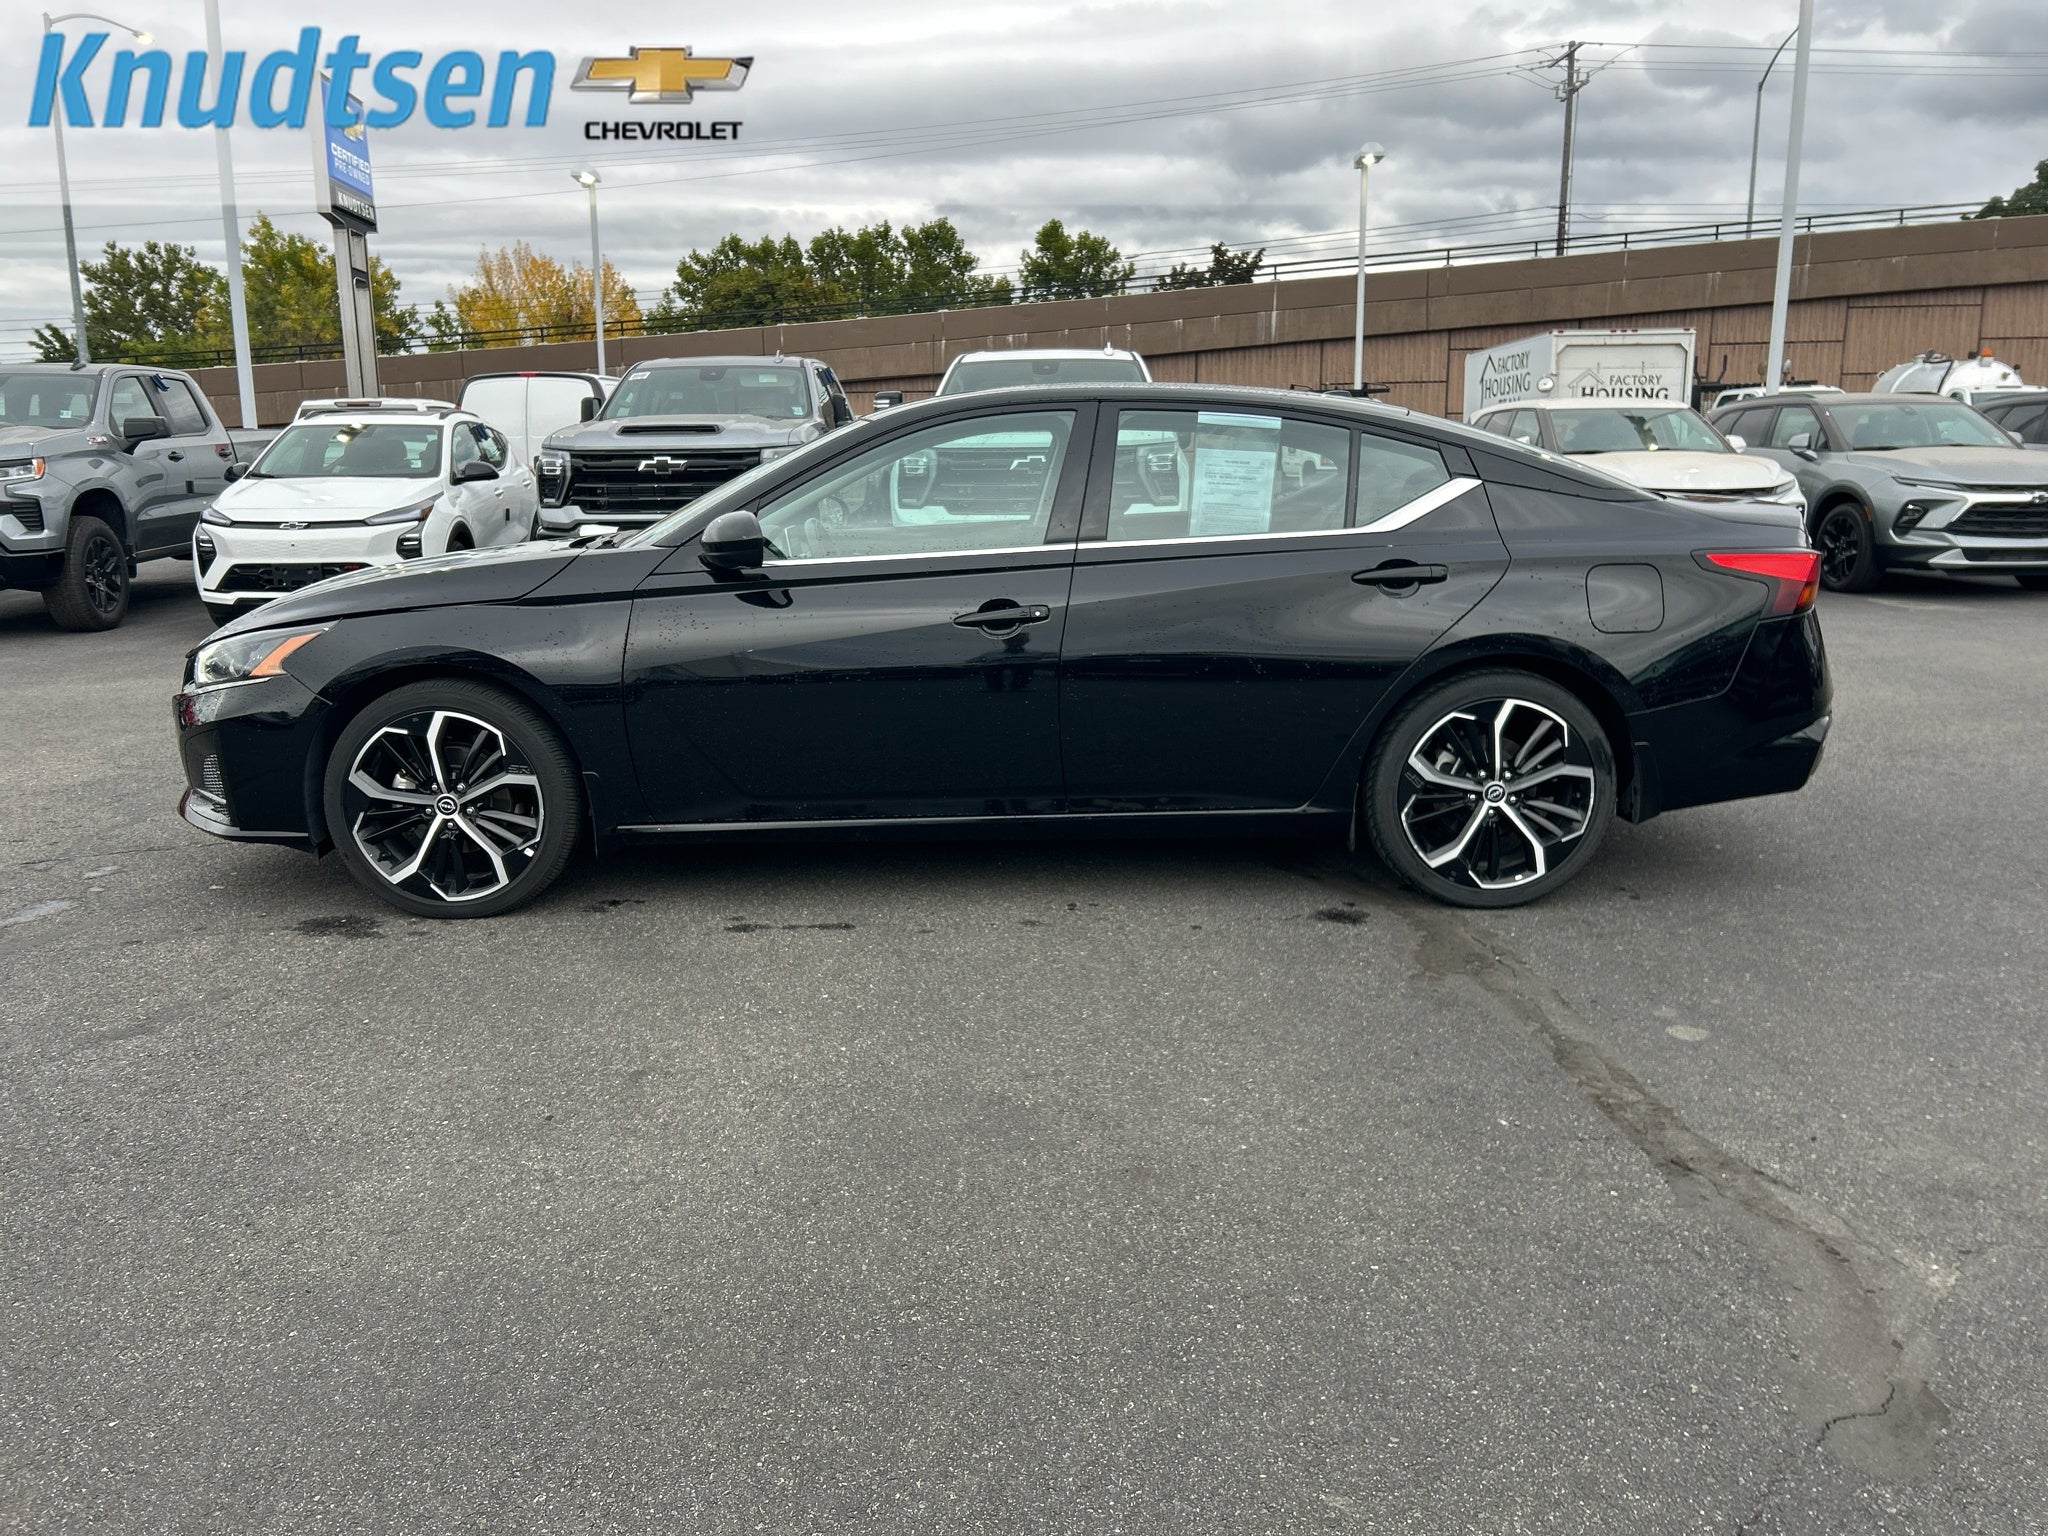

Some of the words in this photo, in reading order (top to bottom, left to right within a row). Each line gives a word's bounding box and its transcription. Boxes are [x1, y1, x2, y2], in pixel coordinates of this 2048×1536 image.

[331, 142, 370, 174] CERTIFIED
[334, 158, 370, 185] PRE-OWNED
[337, 191, 375, 220] KNUDTSEN
[1498, 350, 1530, 374] FACTORY
[1485, 372, 1531, 399] HOUSING
[1609, 374, 1663, 386] FACTORY
